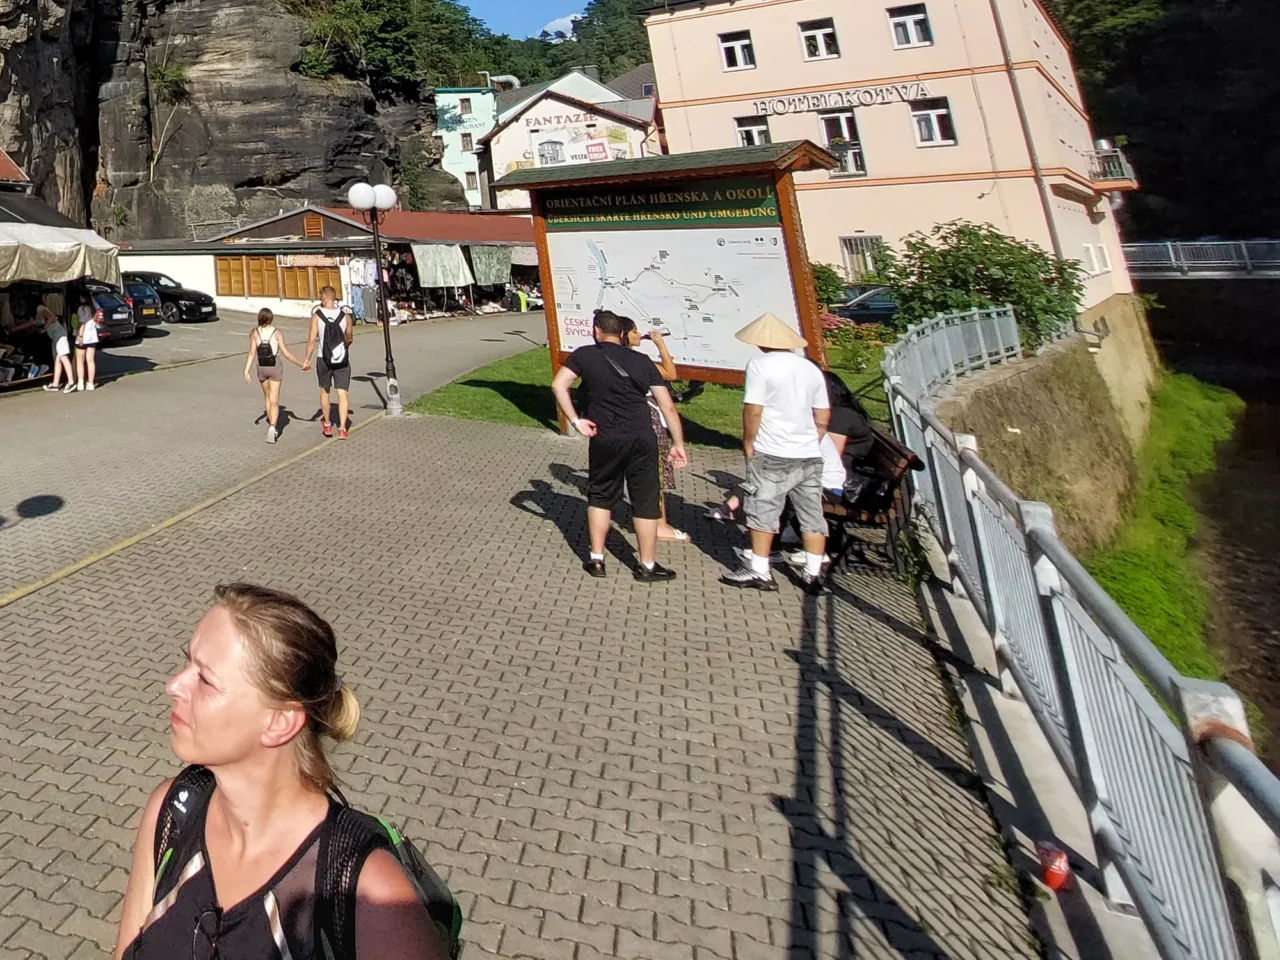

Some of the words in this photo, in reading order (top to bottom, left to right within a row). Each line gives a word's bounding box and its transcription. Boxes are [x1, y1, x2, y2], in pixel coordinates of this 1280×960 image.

[525, 113, 599, 127] FANTAZIE
[587, 145, 604, 153] FREE
[570, 153, 589, 161] VELTA
[589, 152, 608, 160] SHOP
[546, 195, 613, 208] ORIENTAČNÍ
[615, 193, 646, 206] PLÁN
[649, 191, 709, 205] HŘENSKA
[713, 190, 722, 201] A
[725, 186, 773, 201] OKOLÍ
[632, 209, 681, 222] HŘENSKO
[682, 210, 707, 220] UND
[709, 206, 777, 219] UMGEBUNG
[563, 316, 591, 328] ČESKÉ
